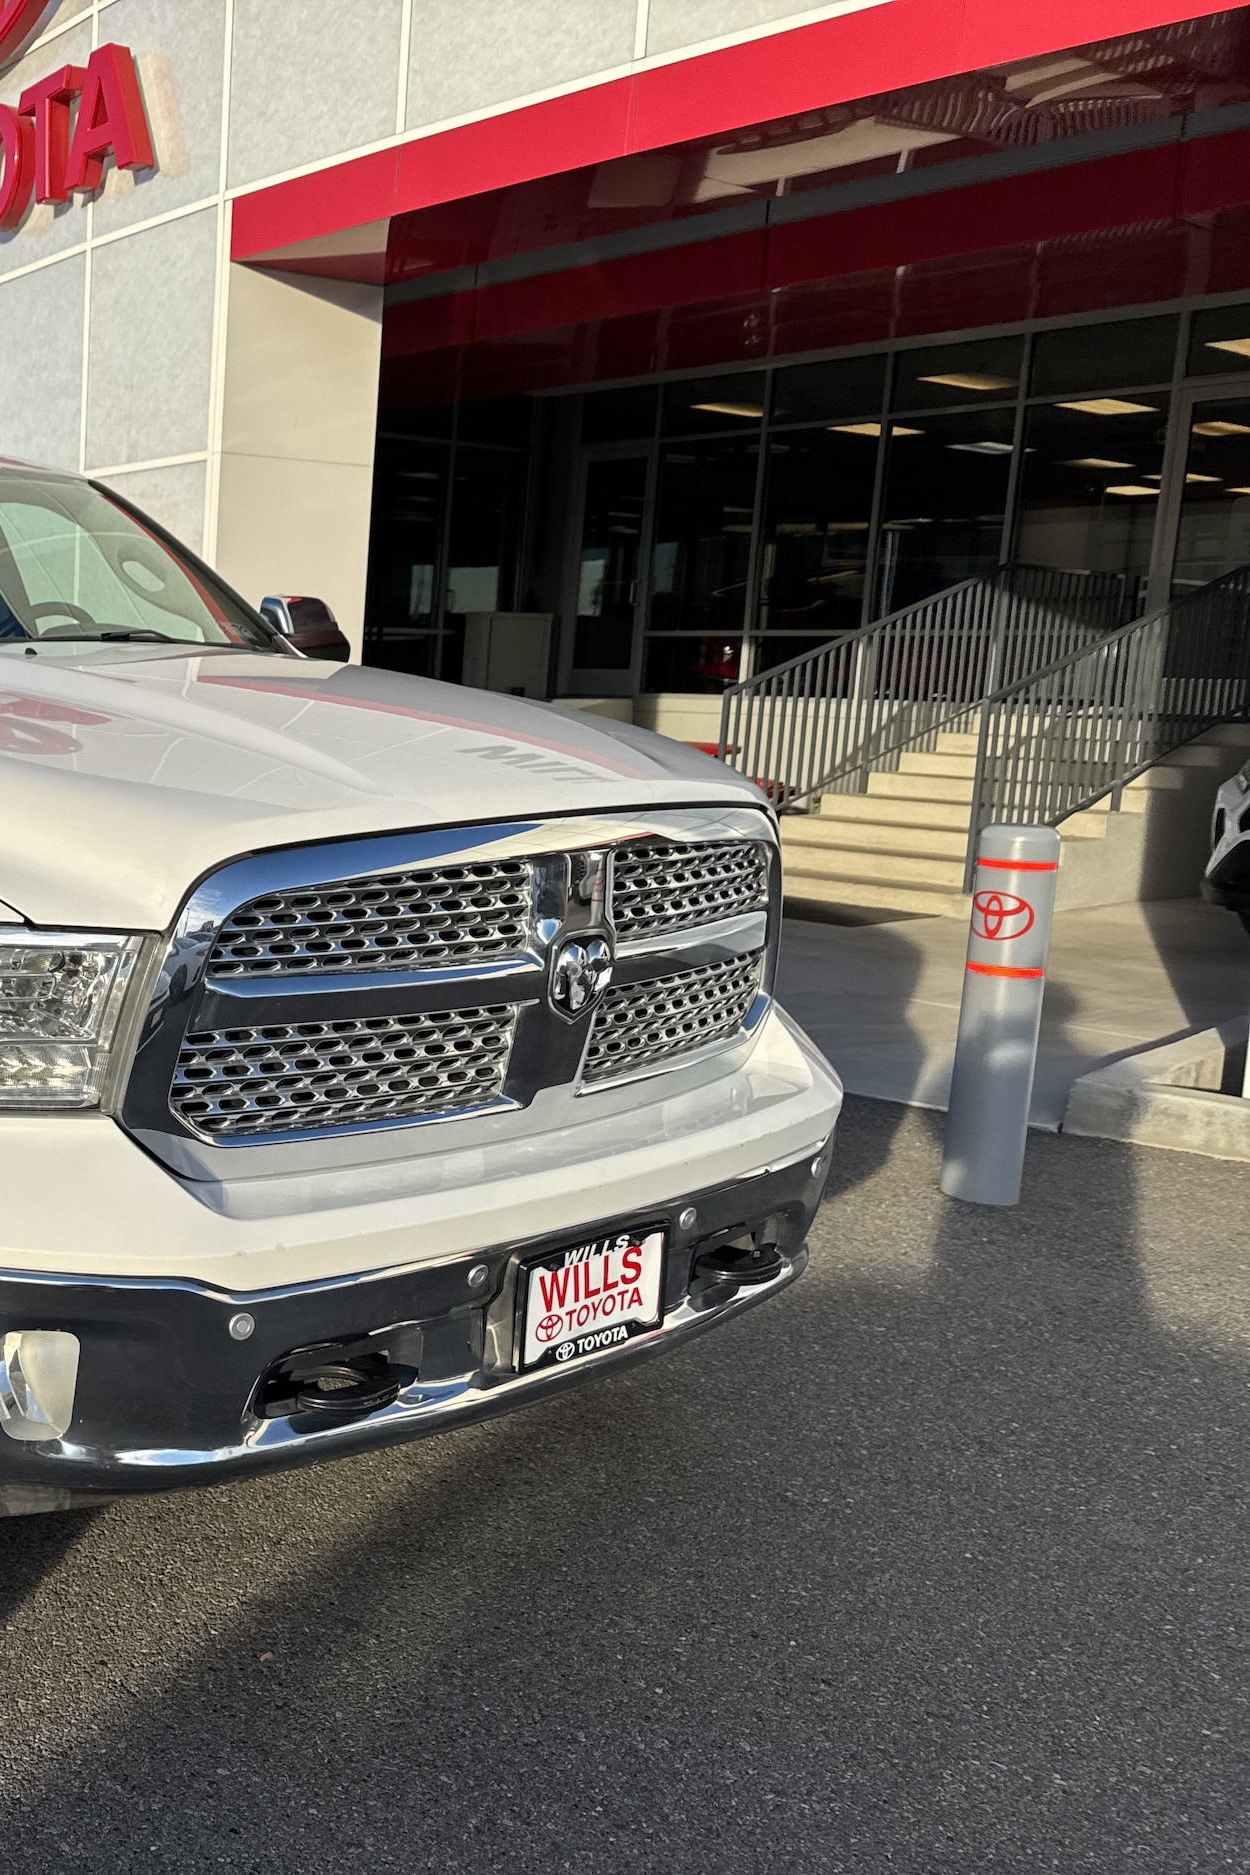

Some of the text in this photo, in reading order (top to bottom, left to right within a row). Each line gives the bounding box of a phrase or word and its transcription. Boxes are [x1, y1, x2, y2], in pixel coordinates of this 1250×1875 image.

[563, 1234, 630, 1268] WILLS
[539, 1245, 643, 1313] WILLS
[565, 1286, 643, 1331] TOYOTA
[576, 1325, 629, 1353] TOYOTA
